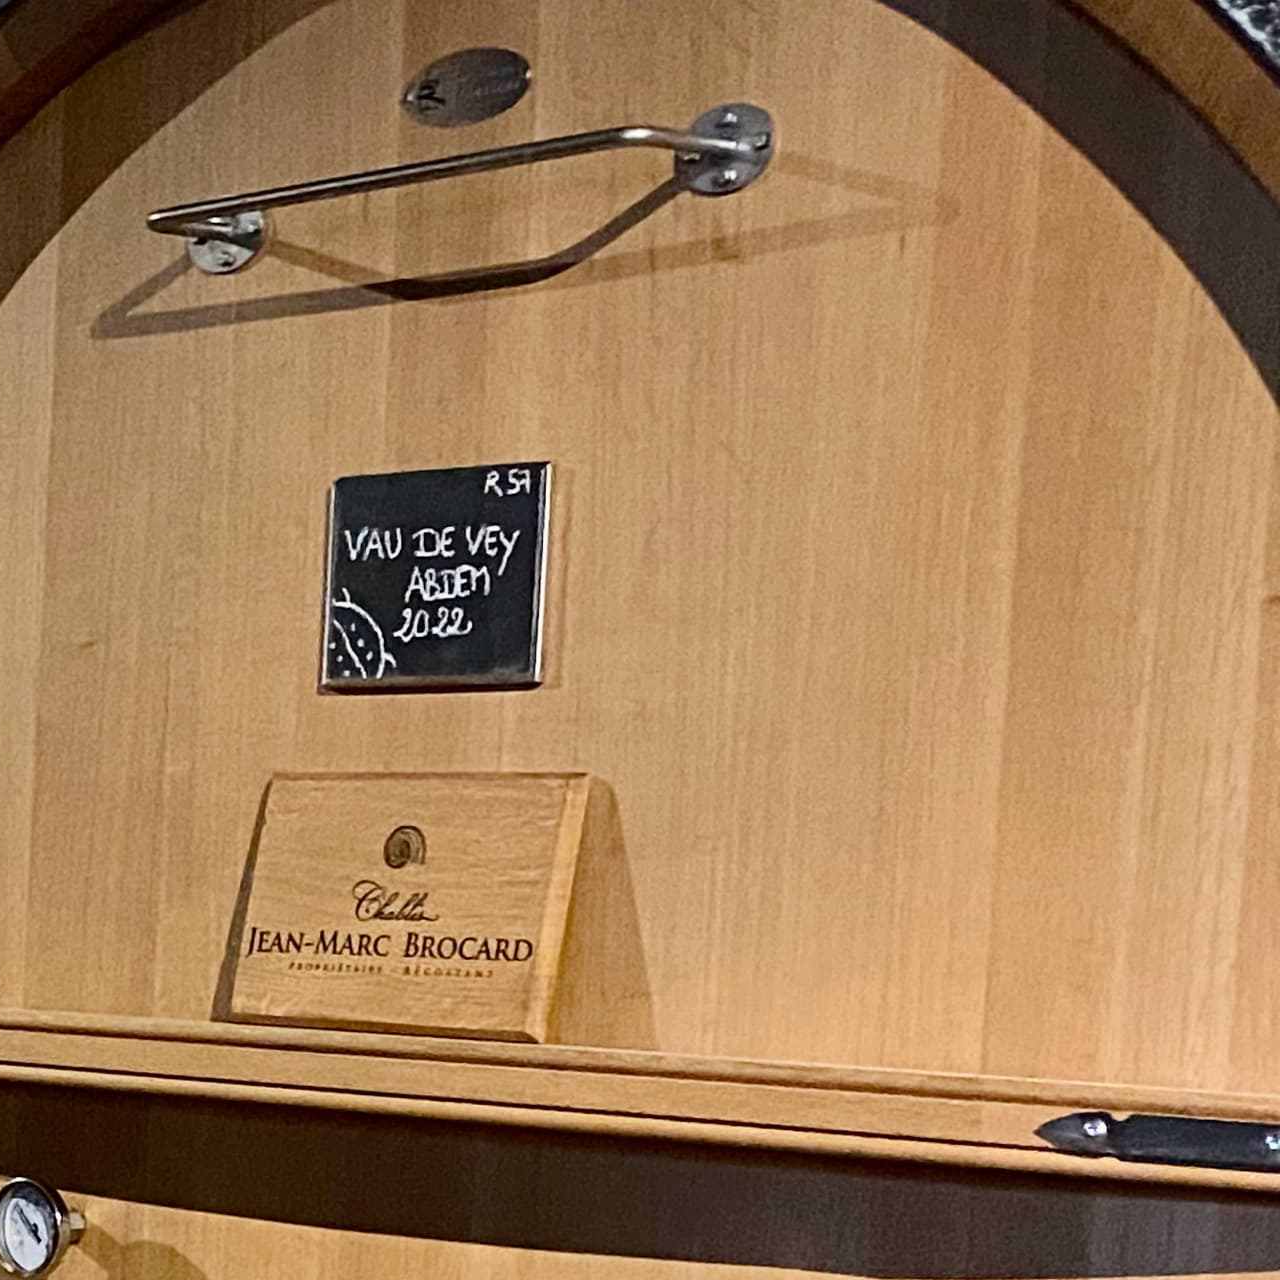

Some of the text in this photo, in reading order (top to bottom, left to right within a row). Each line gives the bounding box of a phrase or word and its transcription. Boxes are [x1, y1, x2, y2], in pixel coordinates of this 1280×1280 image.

[344, 524, 521, 576] VAU DE VEY
[393, 607, 473, 642] 2022
[352, 879, 441, 922] Chablis
[245, 926, 534, 962] JEAN-MARC BROCARD
